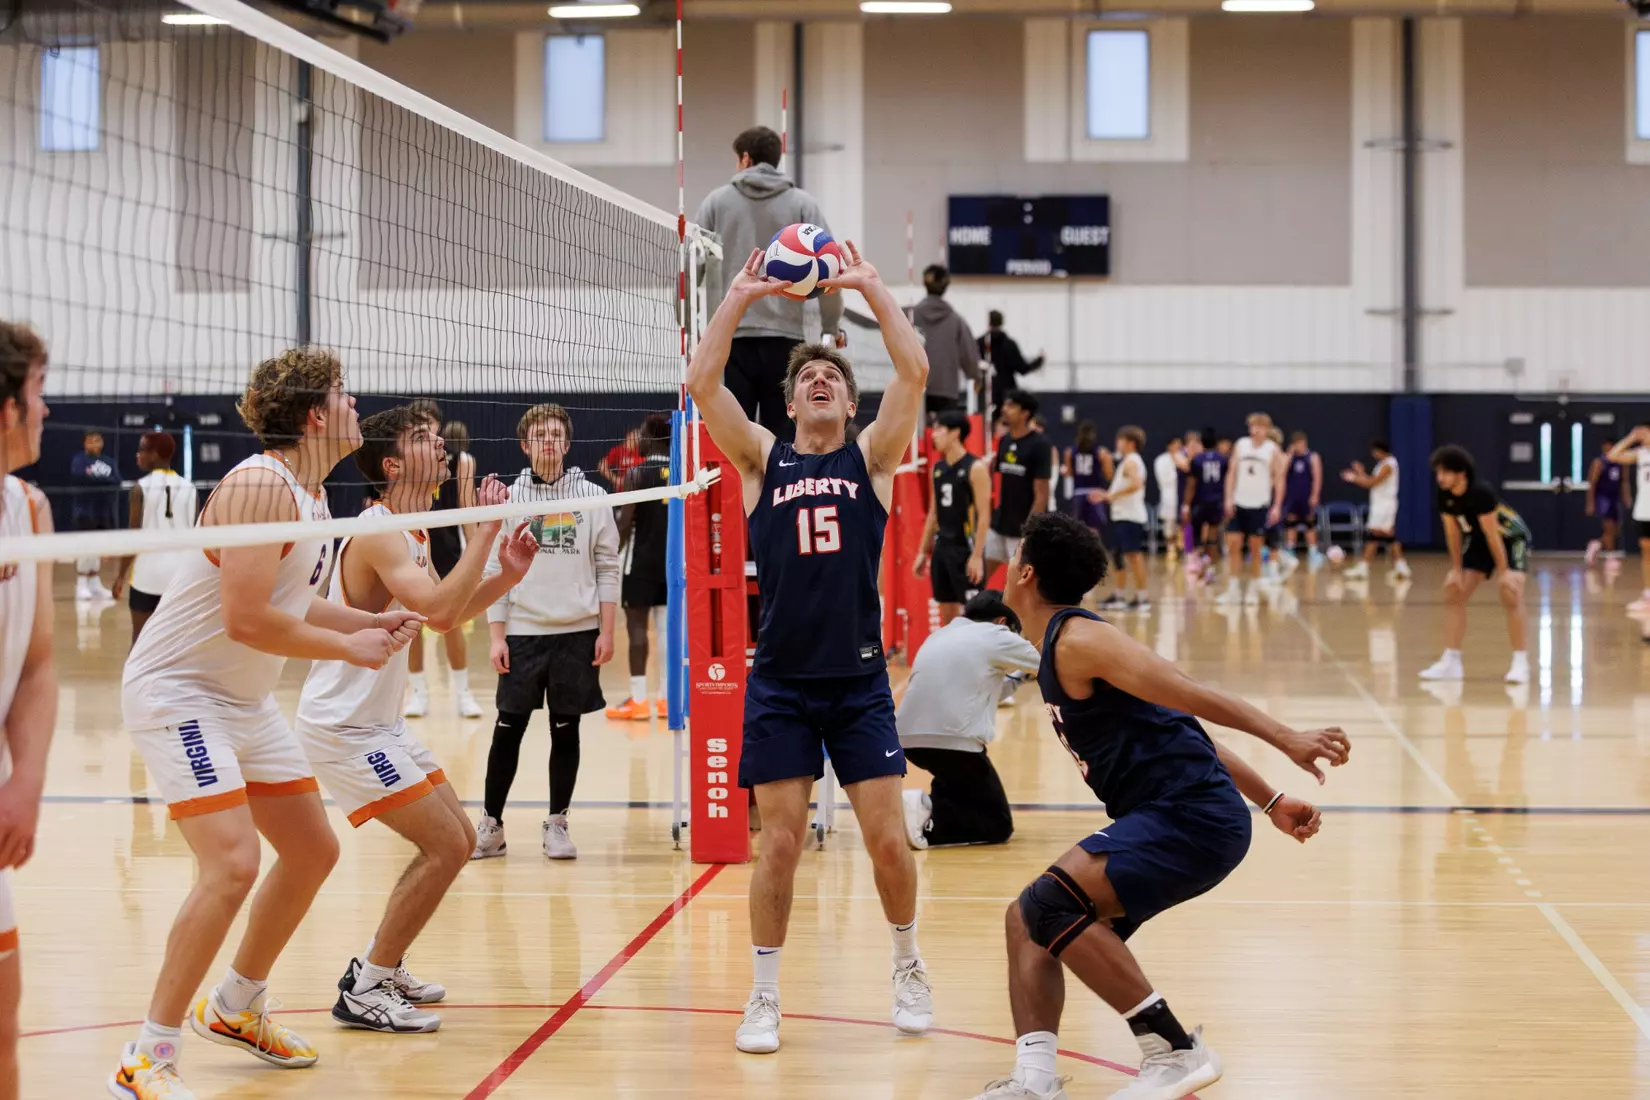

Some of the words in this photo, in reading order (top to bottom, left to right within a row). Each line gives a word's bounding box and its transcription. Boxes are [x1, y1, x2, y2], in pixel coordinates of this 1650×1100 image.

[950, 226, 991, 246] HOME
[1060, 226, 1109, 246] GUEST
[164, 485, 174, 518] 1
[772, 477, 859, 508] LIBERTY
[941, 483, 953, 507] 3
[796, 504, 842, 556] 15
[309, 544, 327, 586] 6
[178, 719, 218, 788] VIRGINI
[365, 750, 402, 788] VIRG
